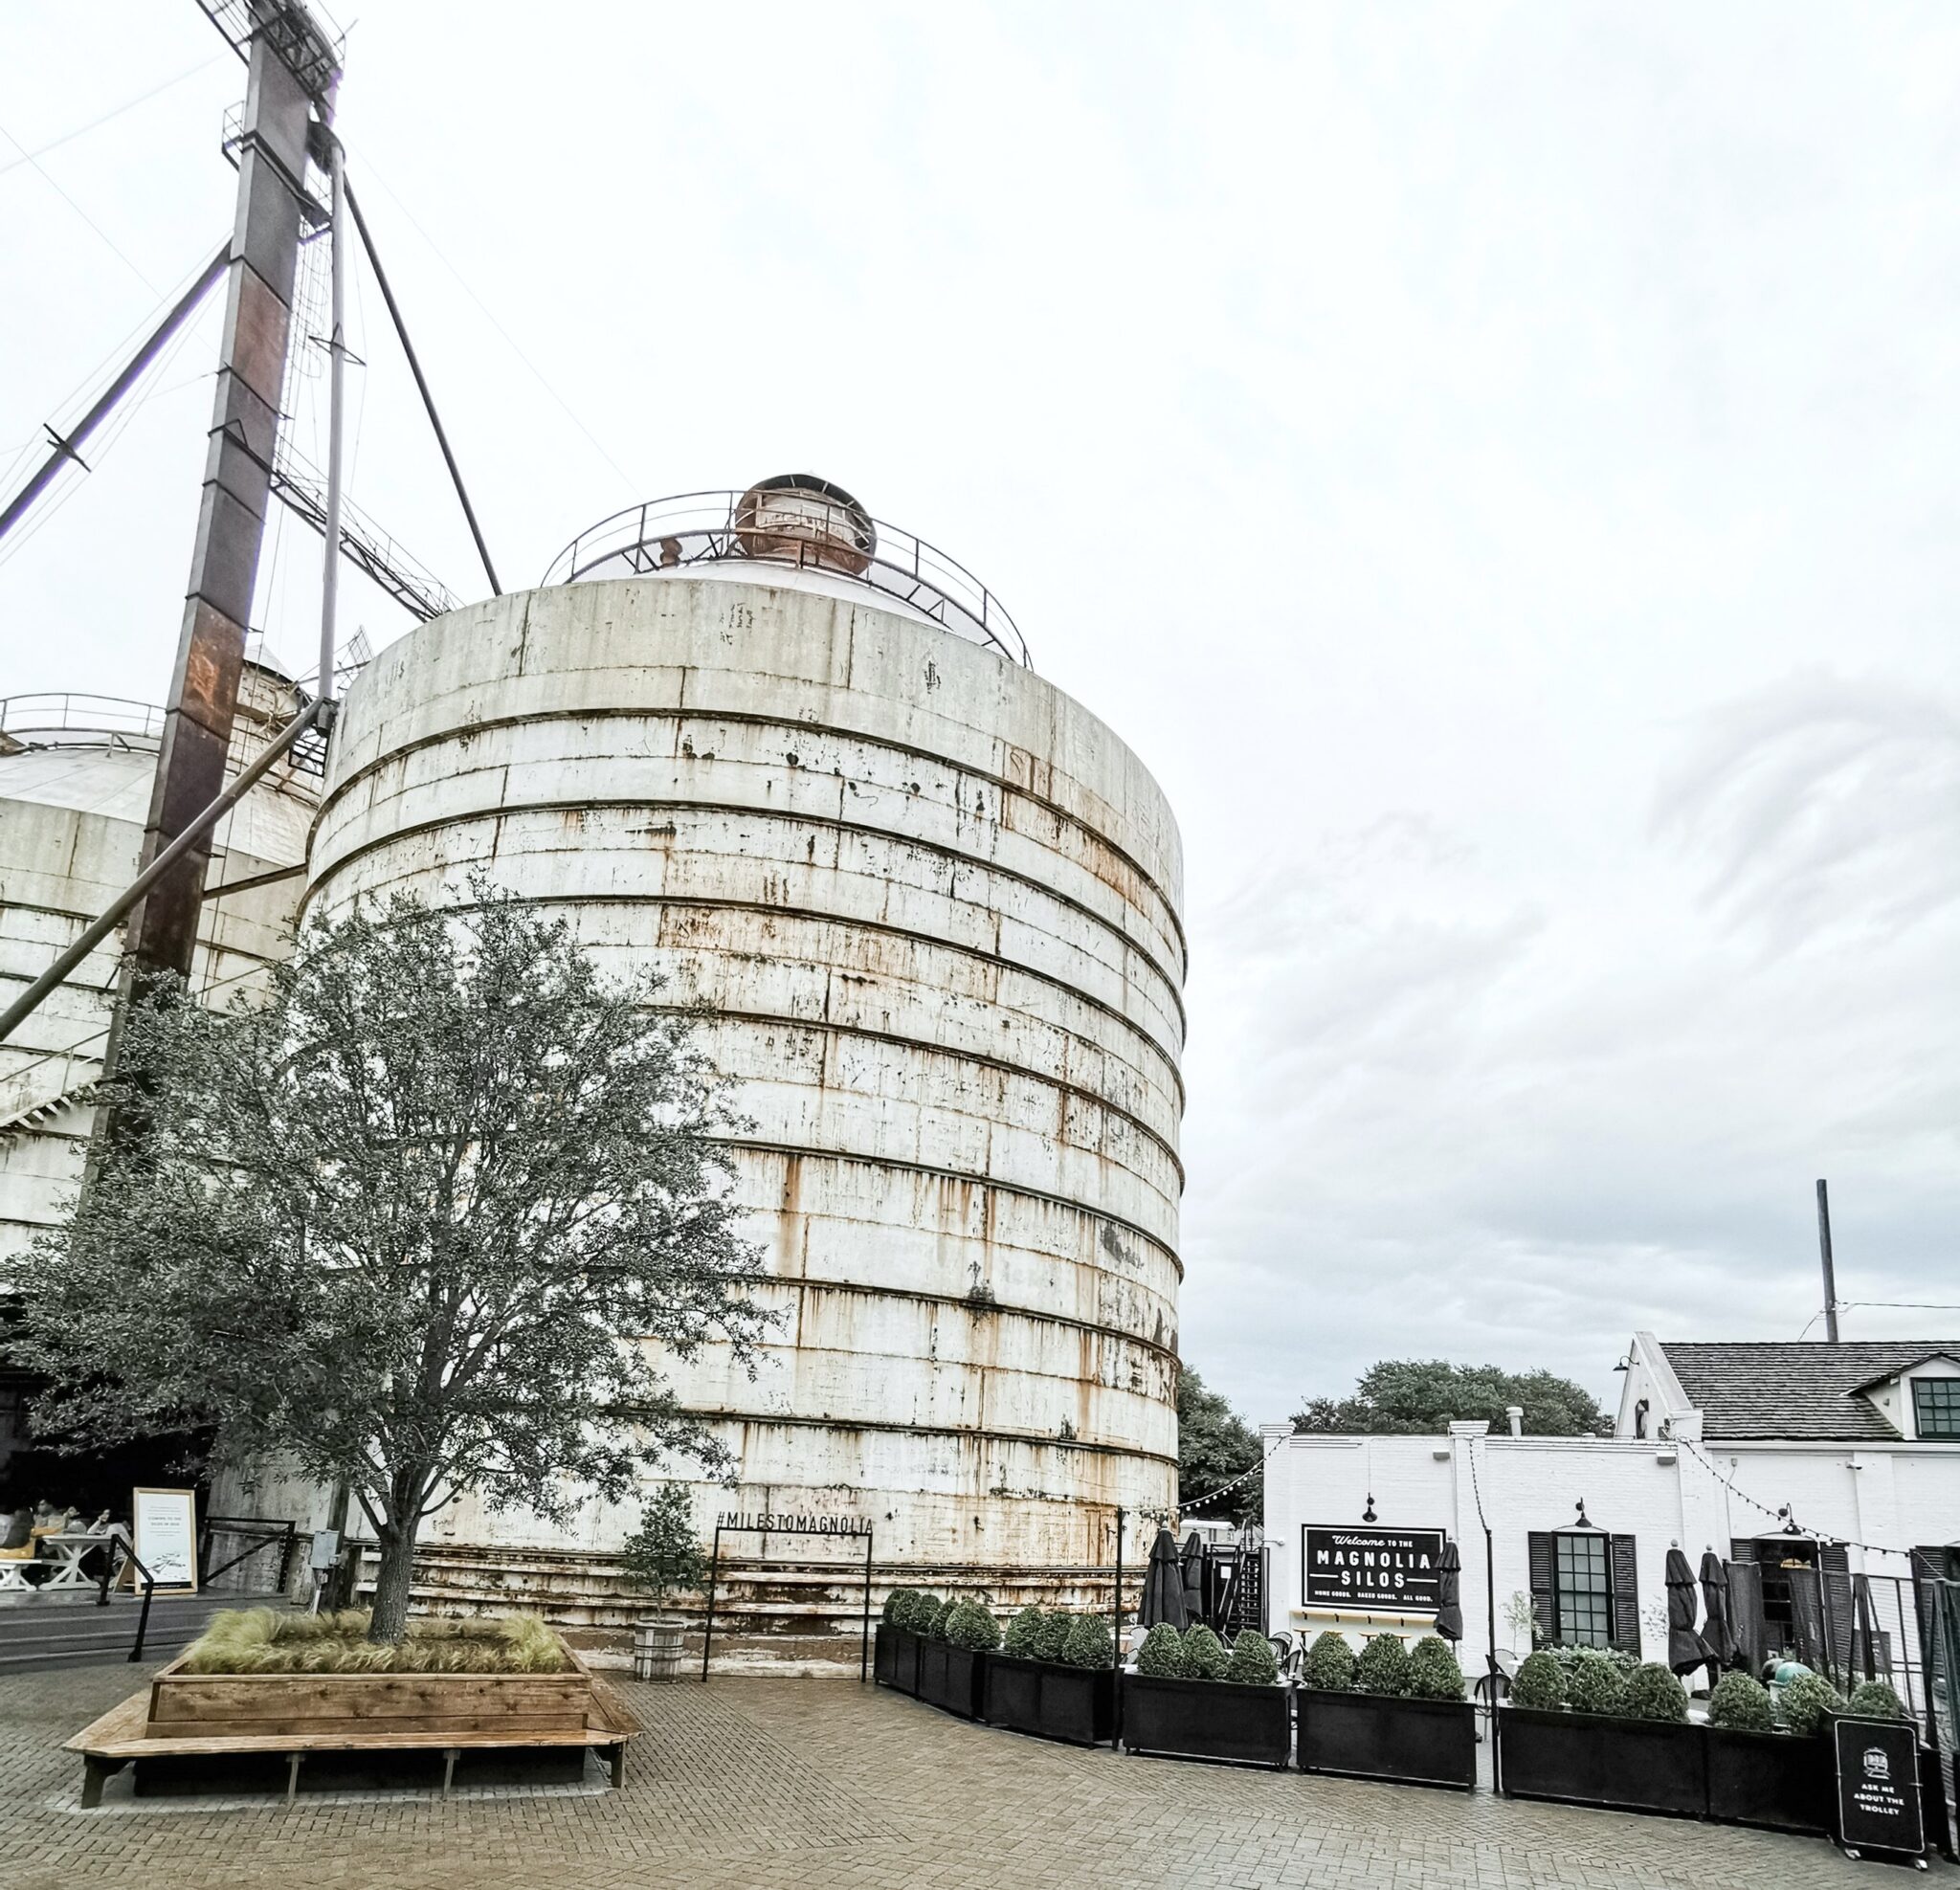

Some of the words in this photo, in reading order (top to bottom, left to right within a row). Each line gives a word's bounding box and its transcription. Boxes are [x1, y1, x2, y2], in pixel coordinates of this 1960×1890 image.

[717, 1511, 873, 1533] #MILESTOMAGNOLIA
[1332, 1535, 1385, 1546] Welcome
[1317, 1550, 1431, 1569] MAGNOLIA
[1341, 1570, 1405, 1588] SILOS
[1861, 1783, 1879, 1791] ASK
[1854, 1792, 1883, 1802] ABOUT
[1886, 1797, 1904, 1806] THE
[1860, 1803, 1900, 1815] TROLLEY
